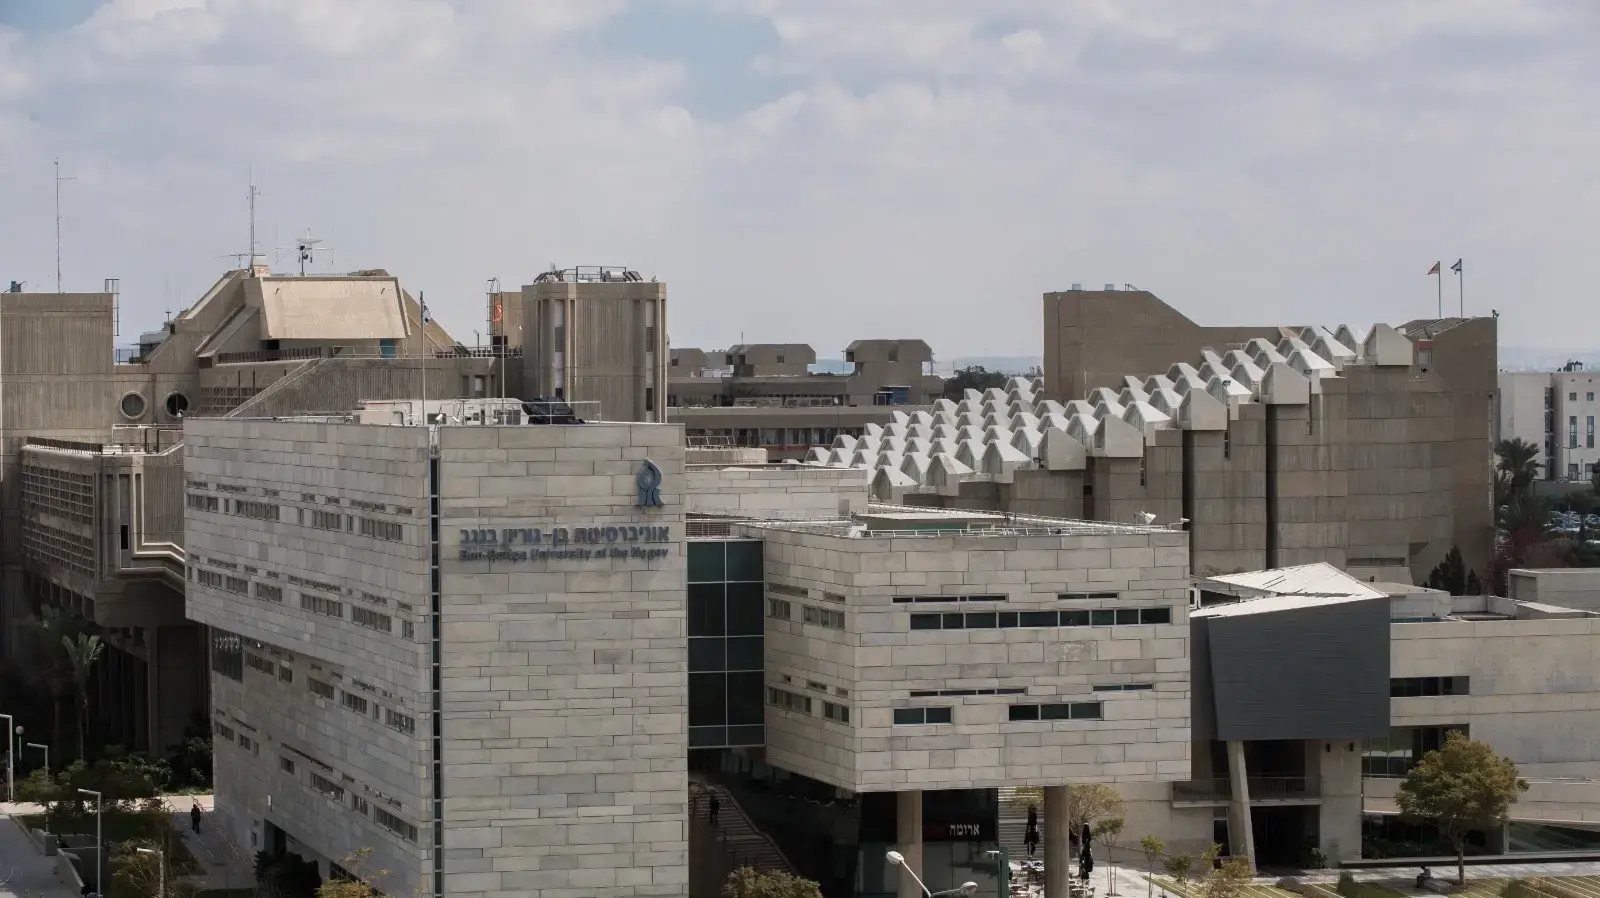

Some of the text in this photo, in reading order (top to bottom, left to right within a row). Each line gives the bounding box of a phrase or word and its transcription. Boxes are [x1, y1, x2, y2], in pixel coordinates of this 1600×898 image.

[459, 528, 498, 544] בנגב
[573, 526, 670, 544] אוניברסיטת
[531, 548, 591, 561] University
[595, 547, 607, 559] of
[609, 547, 628, 559] the
[631, 546, 669, 561] Negev
[949, 823, 980, 836] ארומה
